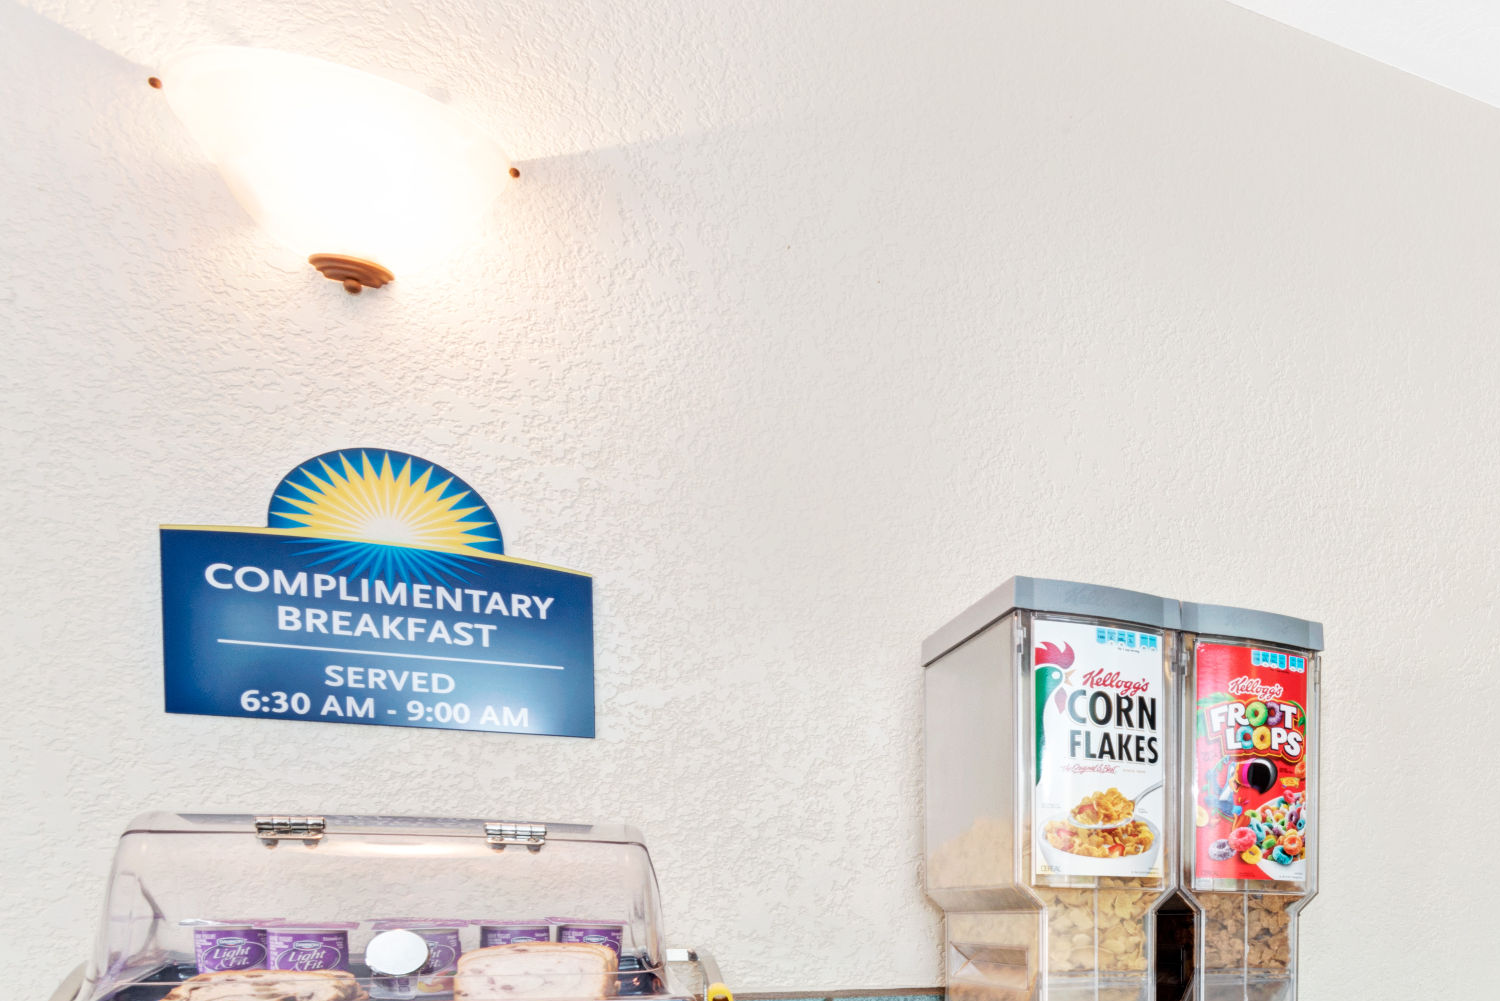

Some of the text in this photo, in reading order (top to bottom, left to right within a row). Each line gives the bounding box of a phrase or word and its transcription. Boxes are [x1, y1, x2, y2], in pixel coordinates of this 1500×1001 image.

[204, 563, 555, 620] COMPLIMENTARY
[277, 605, 497, 648] BREAKFAST
[325, 665, 456, 694] SERVED
[1082, 668, 1150, 696] Kellogg's
[1229, 676, 1283, 700] Kellogg's
[240, 689, 311, 715] 6:30
[321, 697, 375, 719] AM
[407, 700, 471, 725] 9:00
[480, 705, 529, 728] AM
[1068, 689, 1156, 731] CORN
[1210, 701, 1297, 732] FROOT
[1070, 730, 1158, 764] FLAKES
[1225, 726, 1302, 757] LOOPS
[213, 944, 250, 960] Light
[289, 948, 326, 964] Light
